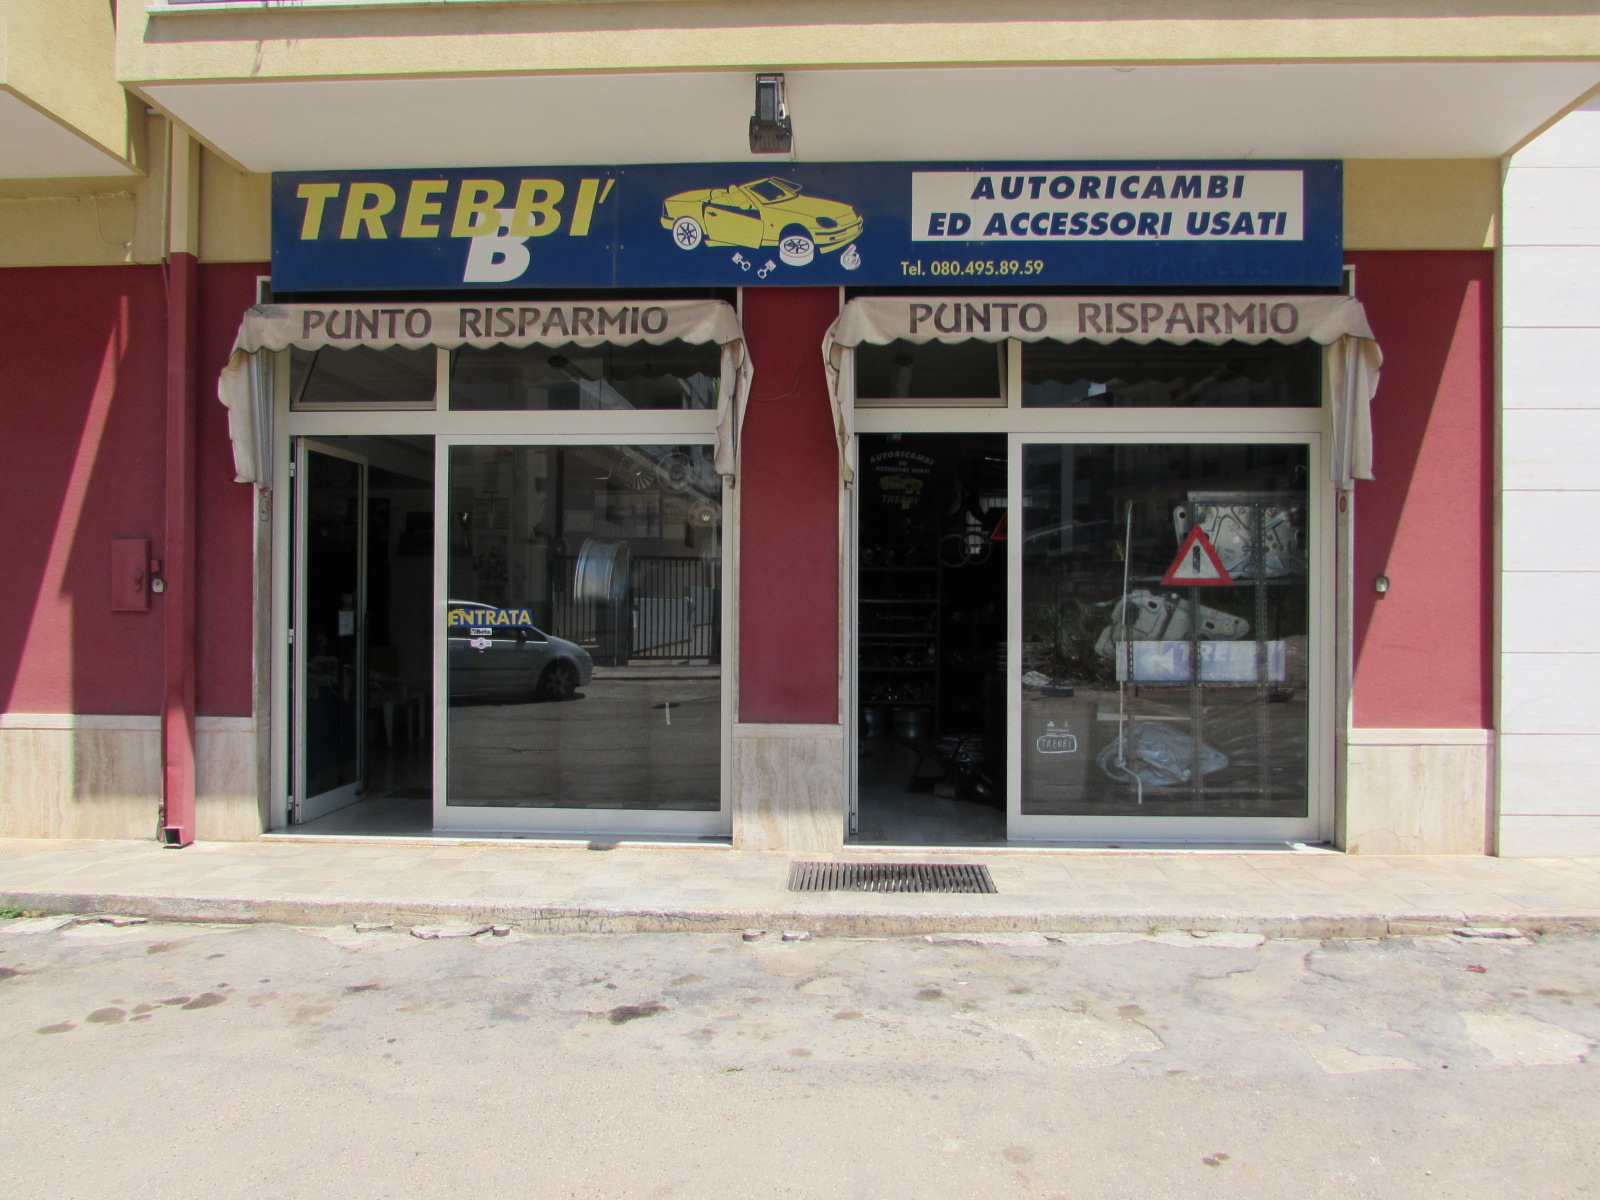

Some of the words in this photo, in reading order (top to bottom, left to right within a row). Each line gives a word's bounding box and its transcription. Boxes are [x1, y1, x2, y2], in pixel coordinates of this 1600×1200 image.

[970, 175, 1244, 200] AUTORICAMBI
[928, 212, 971, 236] ED
[983, 212, 1172, 236] ACCESSORI
[1186, 211, 1287, 236] USATI
[901, 260, 926, 276] Tel.
[931, 260, 1044, 276] 080.495.89.59
[302, 308, 432, 340] PUNTO
[458, 306, 669, 338] RISPARMIO
[909, 302, 1048, 334] PUNTO
[1078, 302, 1299, 334] RISPARMIO
[447, 609, 532, 626] ENTRATA
